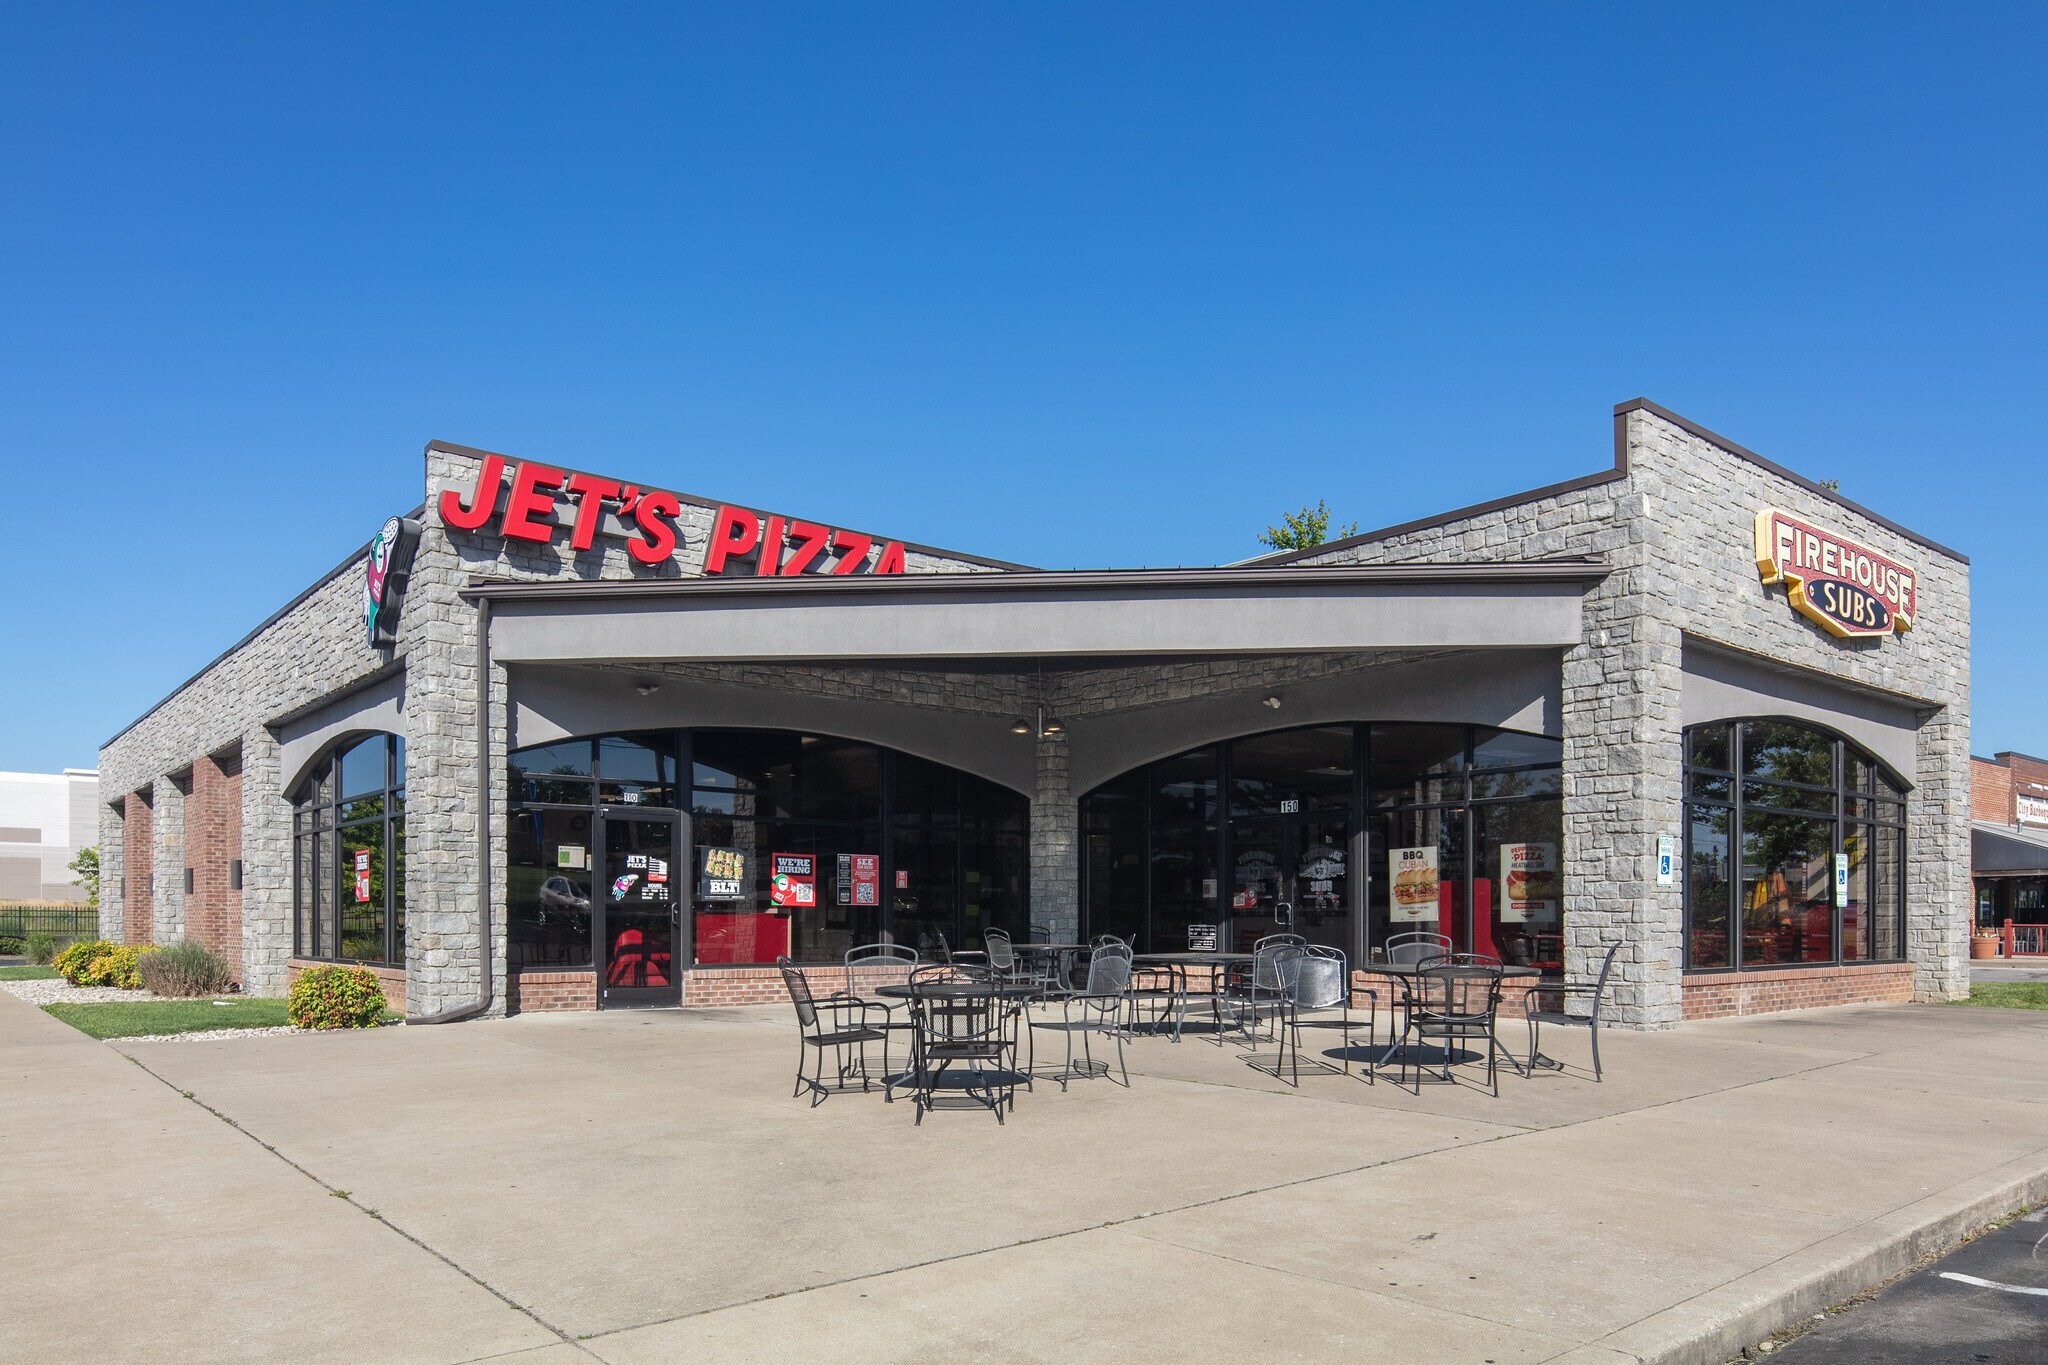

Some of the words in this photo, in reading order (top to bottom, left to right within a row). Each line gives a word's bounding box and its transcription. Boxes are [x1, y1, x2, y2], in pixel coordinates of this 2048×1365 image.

[439, 454, 681, 564] JET'S
[1775, 520, 1913, 631] FIREHOUSE
[1823, 582, 1877, 627] SUBS
[625, 793, 637, 802] 110
[1281, 800, 1298, 812] 150
[2018, 802, 2028, 817] City
[626, 855, 647, 863] JET'S
[1403, 850, 1424, 860] BBQ
[777, 857, 810, 866] WE'RE
[1398, 860, 1428, 870] CUBAN
[777, 866, 810, 874] HIRING
